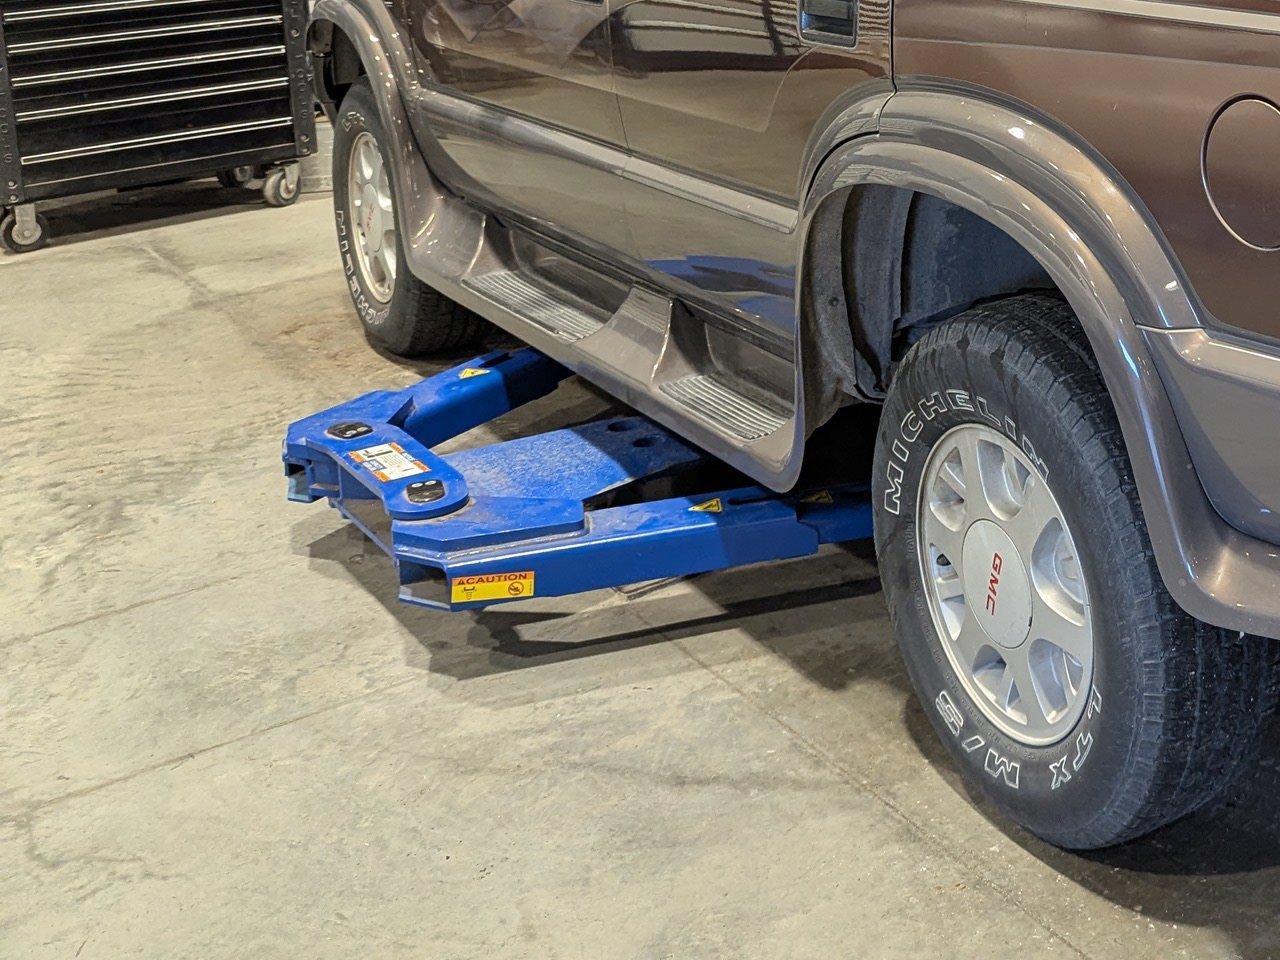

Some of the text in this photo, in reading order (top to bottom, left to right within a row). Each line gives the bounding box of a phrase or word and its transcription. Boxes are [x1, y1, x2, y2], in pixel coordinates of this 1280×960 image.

[884, 388, 1051, 516] MICHELIN
[466, 573, 528, 585] CAUTION
[985, 552, 1003, 617] GMC
